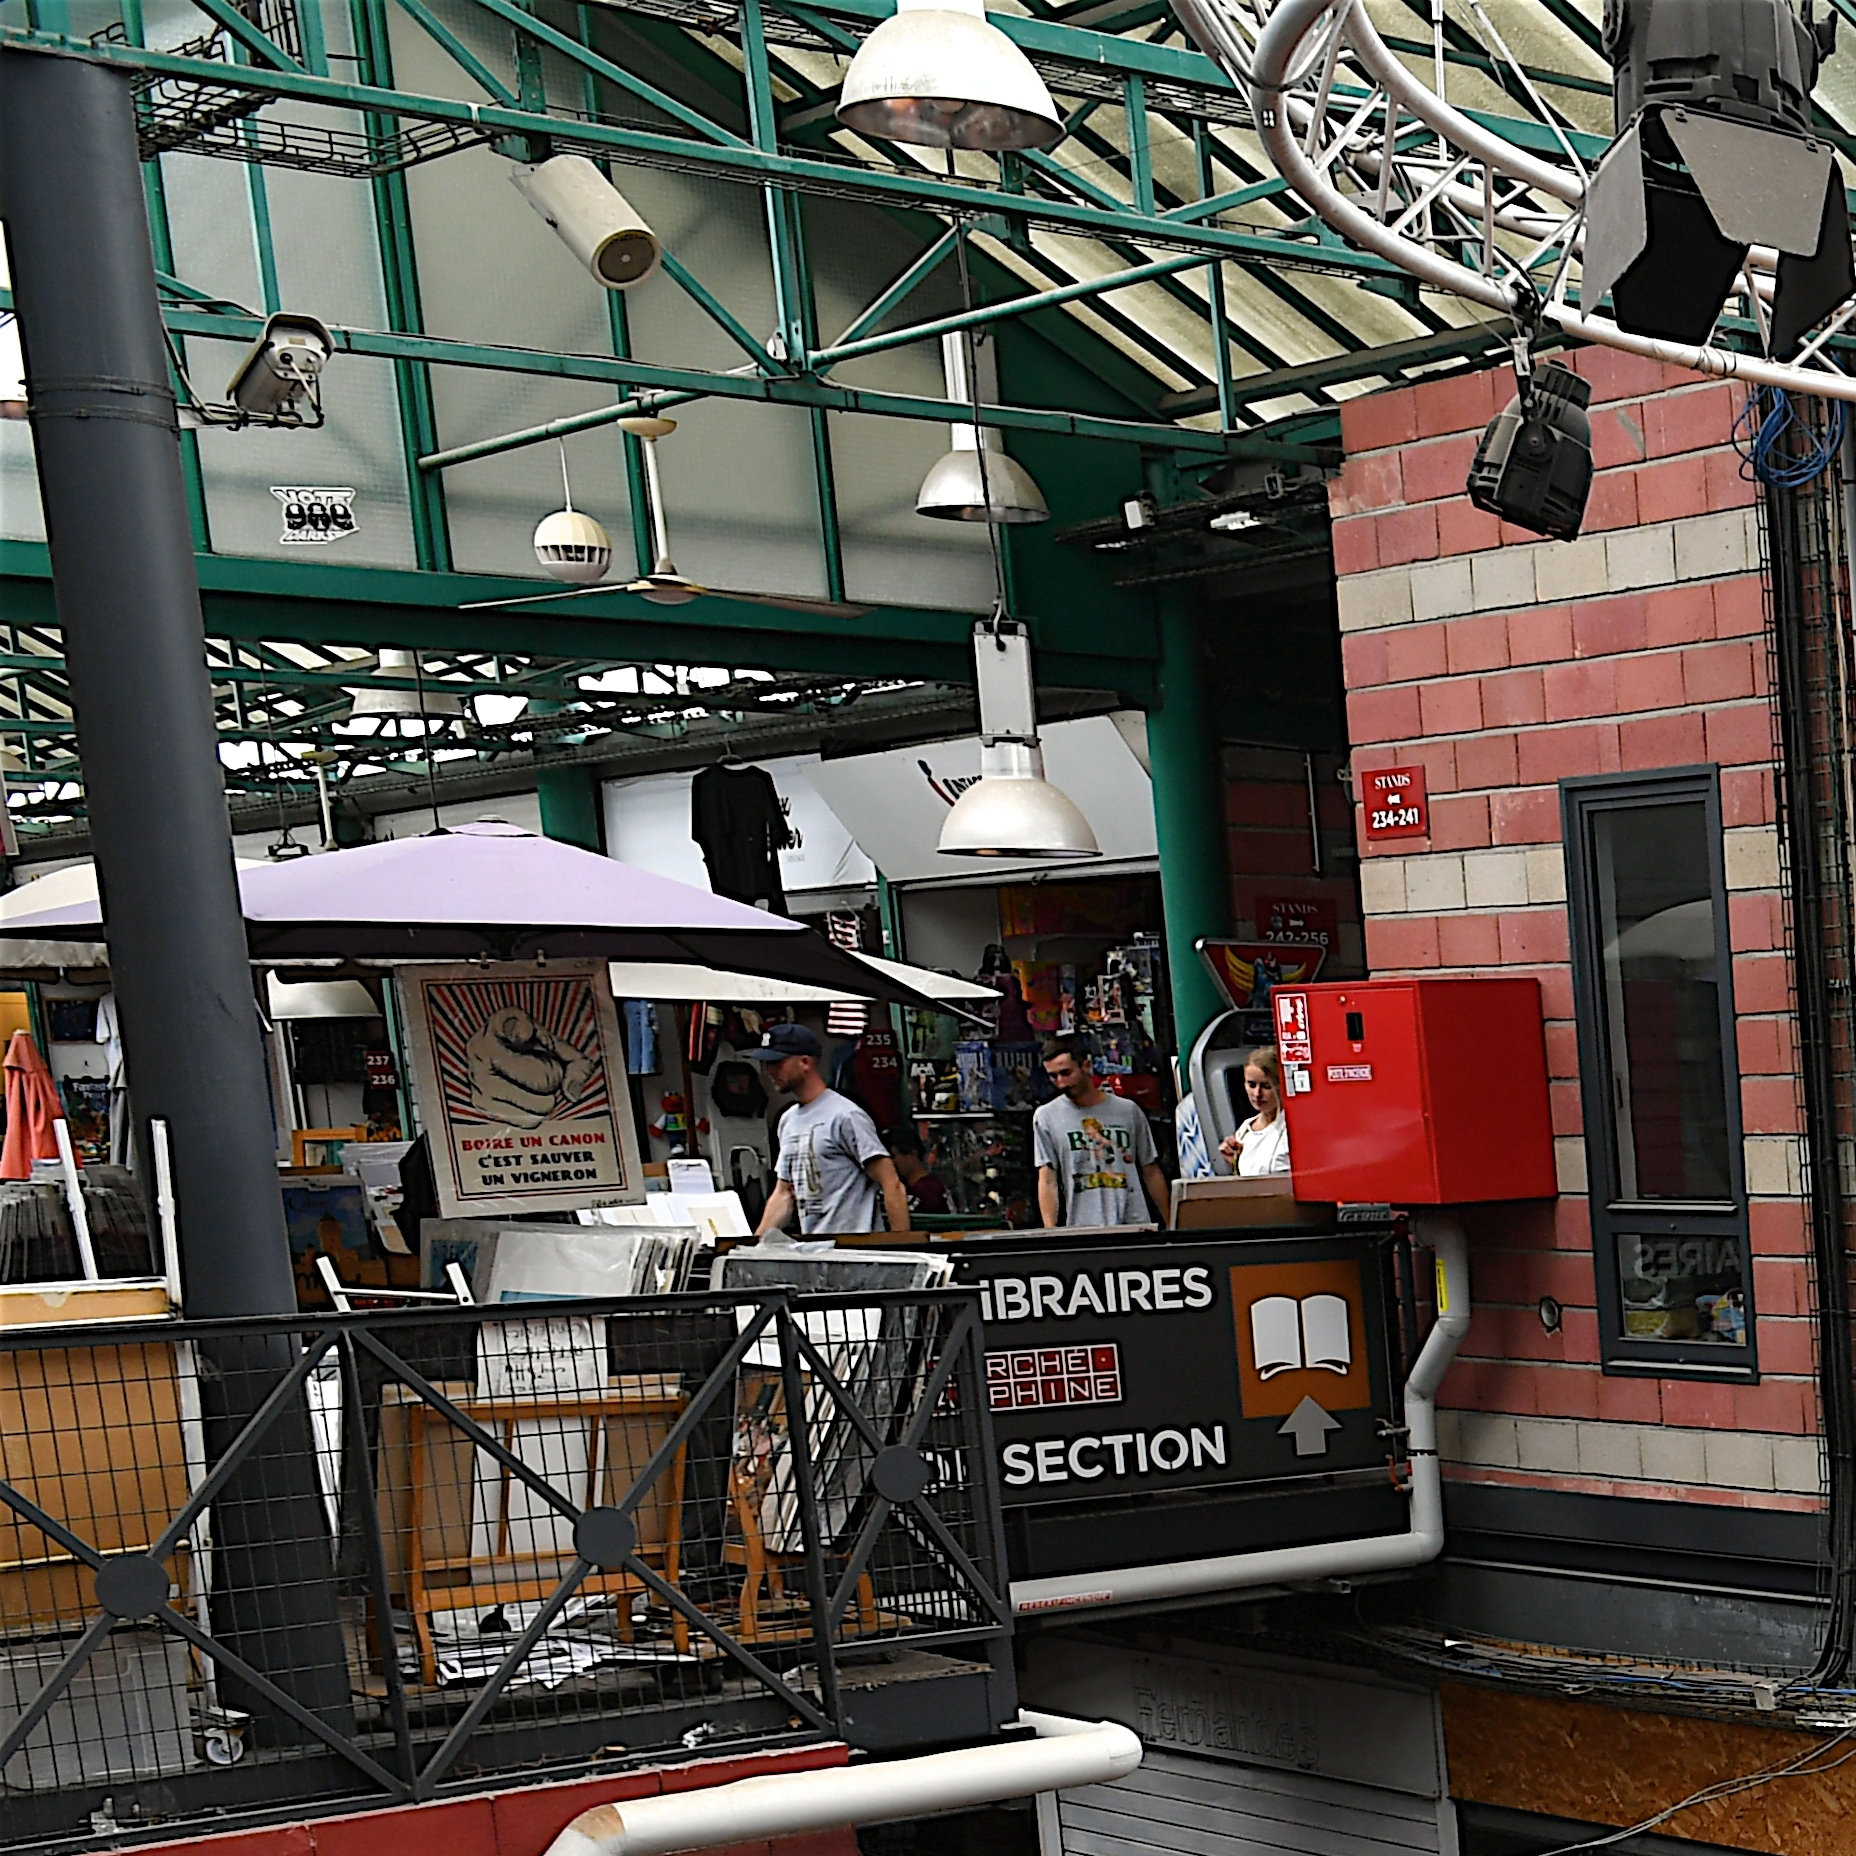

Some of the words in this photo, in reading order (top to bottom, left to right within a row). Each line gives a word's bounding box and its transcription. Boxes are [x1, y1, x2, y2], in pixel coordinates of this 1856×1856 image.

[1374, 773, 1411, 790] STANDS
[1372, 807, 1419, 829] 234-241
[1272, 903, 1318, 914] STANDS
[866, 1034, 891, 1046] 235
[367, 1055, 389, 1066] 237
[872, 1056, 898, 1069] 234
[372, 1074, 396, 1085] 236
[461, 1137, 515, 1152] BOIRE
[520, 1136, 542, 1148] UN
[549, 1132, 606, 1146] CANON
[478, 1154, 523, 1169] C'EST
[530, 1150, 595, 1165] SAUVER
[481, 1173, 505, 1186] UN
[510, 1168, 598, 1185] VIGNERON
[1003, 1425, 1226, 1485] SECTION
